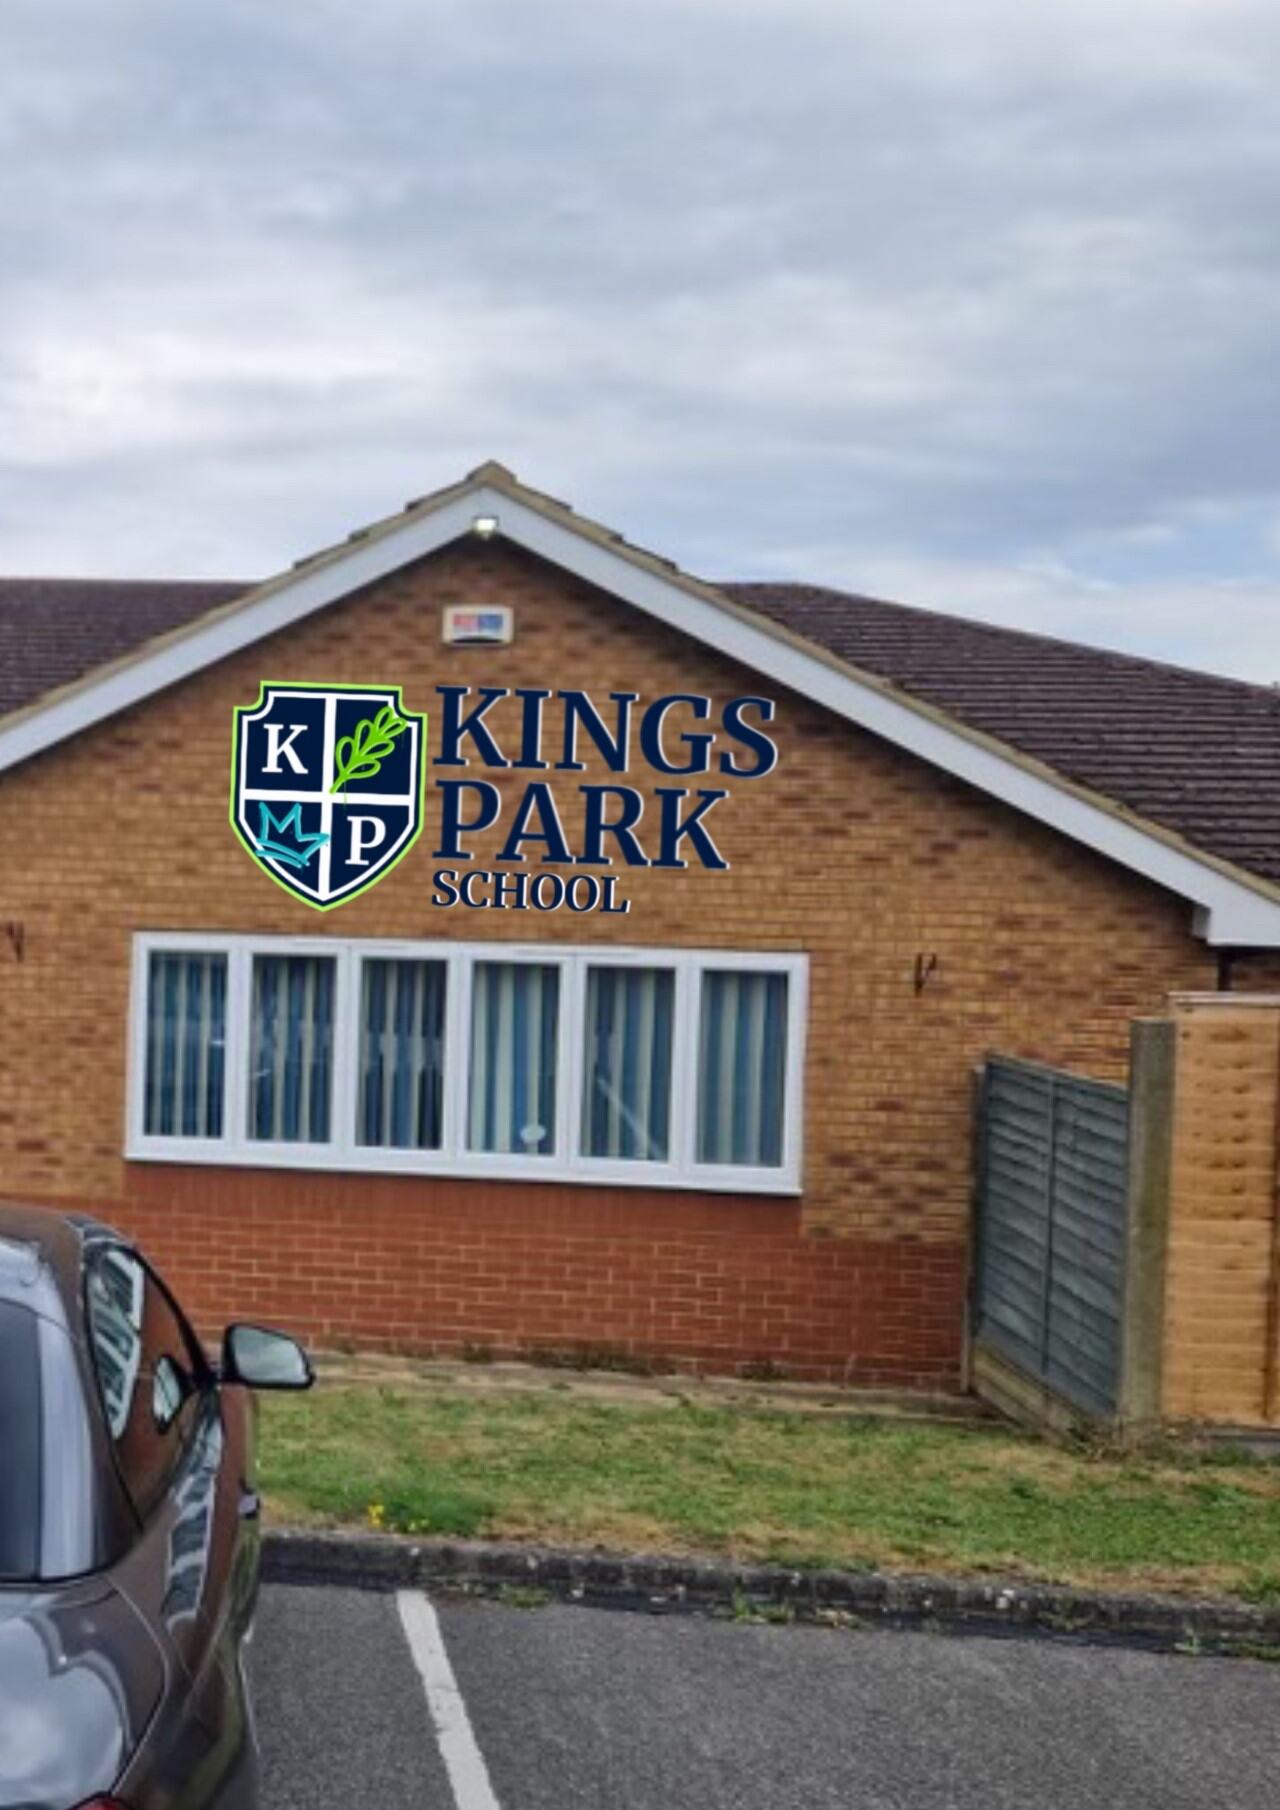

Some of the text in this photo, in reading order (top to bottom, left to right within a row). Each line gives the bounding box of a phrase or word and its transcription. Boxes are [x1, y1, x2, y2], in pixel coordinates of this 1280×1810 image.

[261, 724, 308, 774] K
[432, 685, 778, 778] KINGS
[345, 815, 386, 865] P
[432, 779, 730, 869] PARK
[431, 870, 630, 914] SCHOOL
